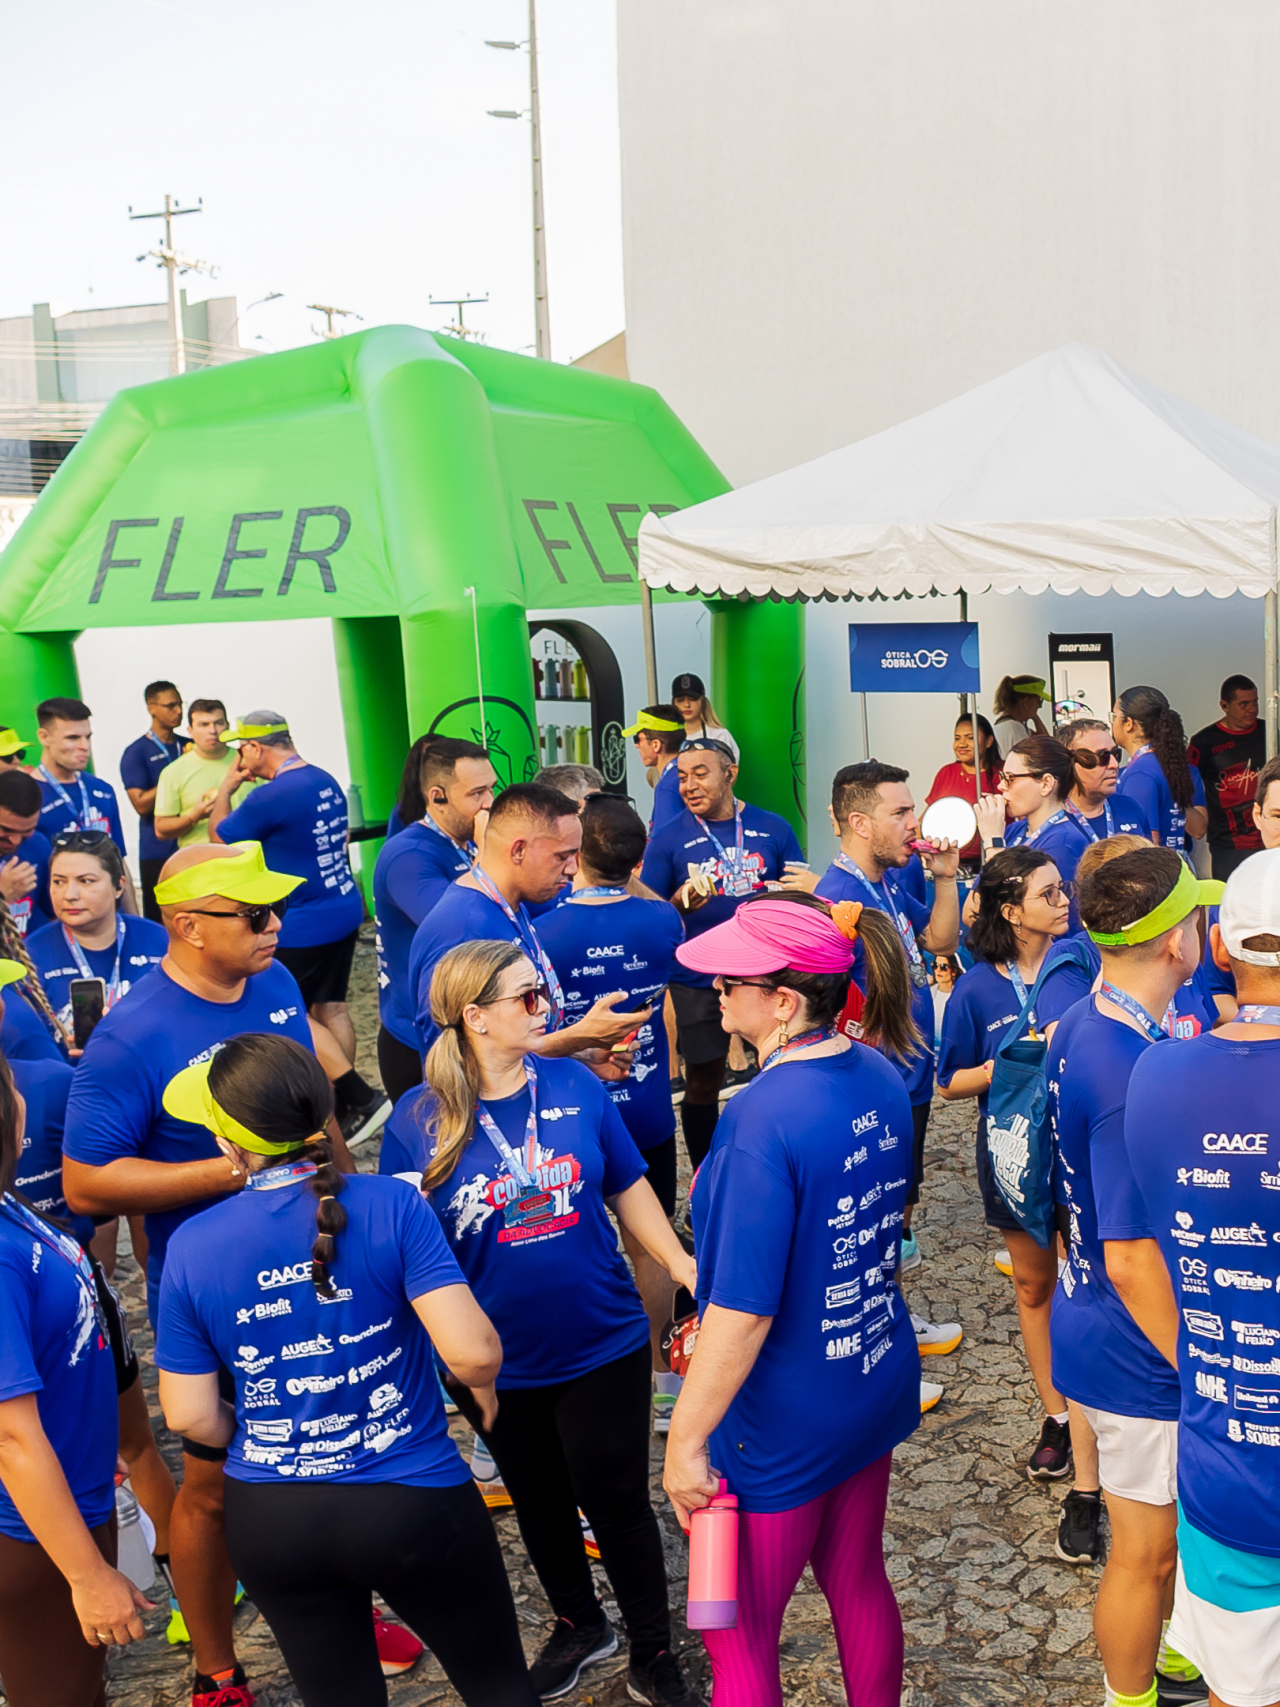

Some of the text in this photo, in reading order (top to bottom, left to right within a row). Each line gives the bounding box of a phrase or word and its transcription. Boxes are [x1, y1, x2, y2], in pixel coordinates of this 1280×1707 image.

[521, 499, 681, 583] FLE
[88, 505, 352, 604] FLER
[1058, 643, 1101, 653] mormaii
[881, 658, 917, 669] SOBRAL
[587, 945, 624, 958] CAACE
[1203, 1133, 1269, 1151] CAACE
[1192, 1168, 1231, 1184] Biofit
[1210, 1226, 1250, 1241] AUGE
[257, 1261, 314, 1288] CAACE
[254, 1297, 291, 1319] Biofit
[281, 1340, 317, 1358] AUGE
